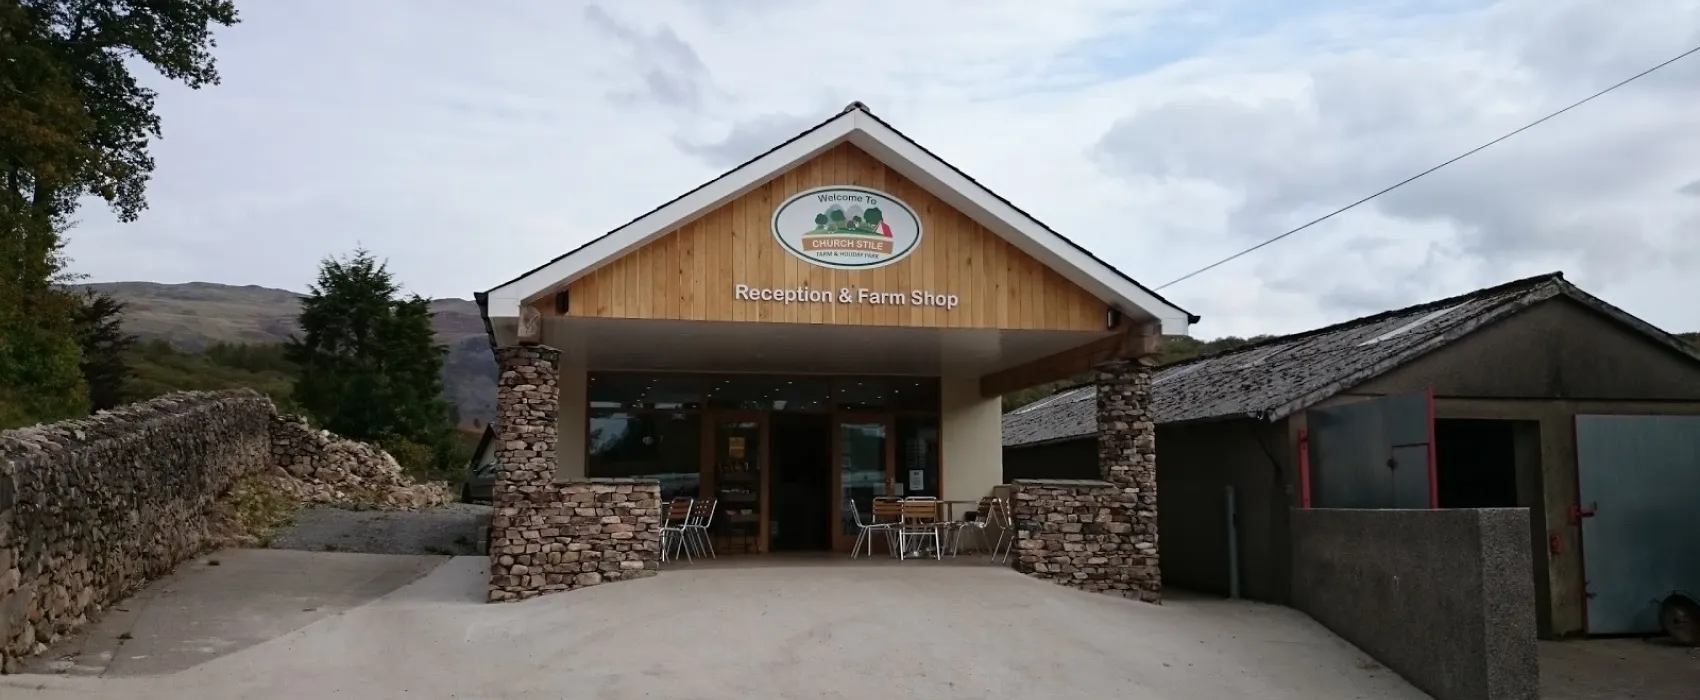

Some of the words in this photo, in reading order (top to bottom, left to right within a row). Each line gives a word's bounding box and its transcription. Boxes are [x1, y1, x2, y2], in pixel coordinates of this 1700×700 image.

[818, 193, 862, 203] Welcome
[865, 195, 877, 205] To
[812, 239, 854, 248] CHURCH
[856, 240, 883, 250] STILE
[735, 284, 833, 304] Reception
[838, 287, 853, 303] &
[858, 288, 905, 305] Farm
[911, 290, 959, 311] Shop
